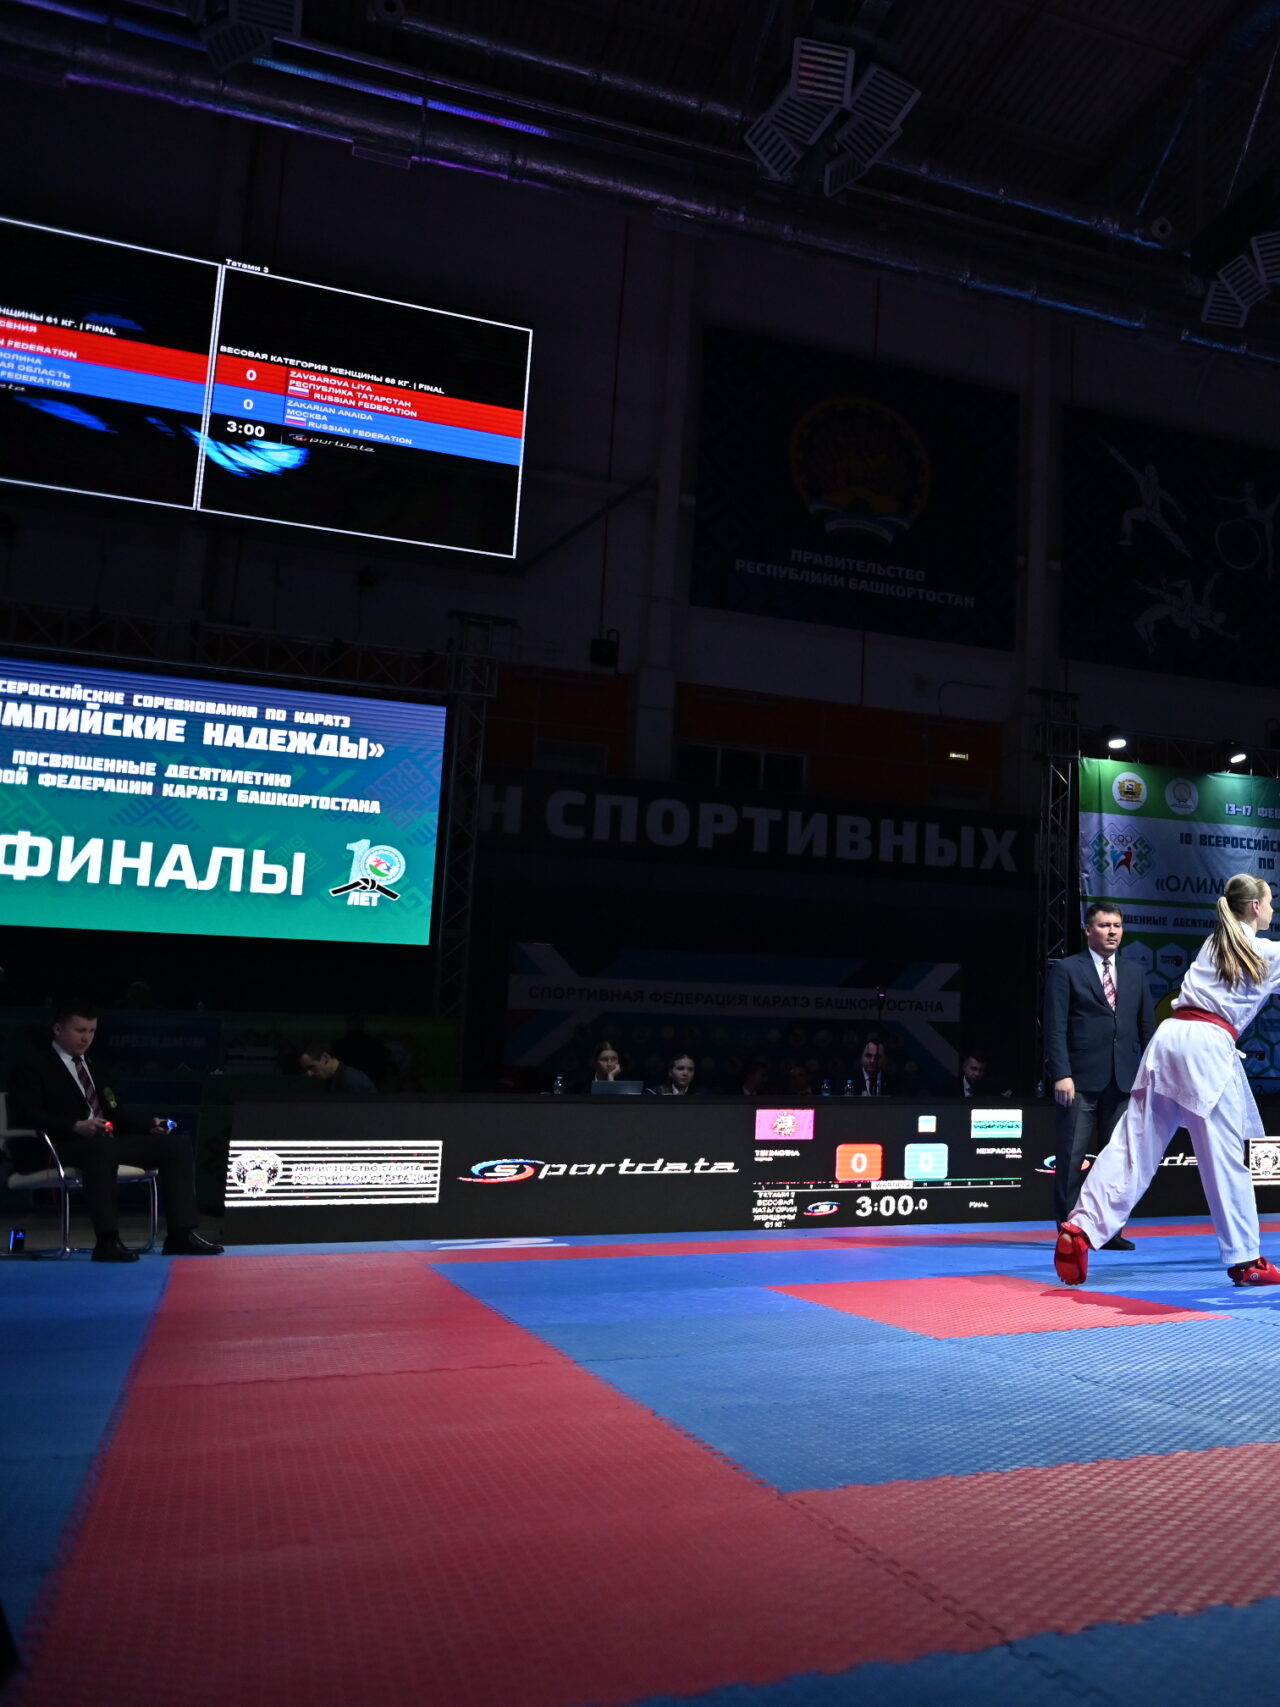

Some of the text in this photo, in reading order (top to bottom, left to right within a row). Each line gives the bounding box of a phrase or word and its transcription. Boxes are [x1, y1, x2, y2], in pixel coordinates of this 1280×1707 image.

[226, 258, 261, 272] Татами
[85, 323, 117, 336] FINAL
[7, 340, 78, 359] FEDERATION
[1, 370, 71, 389] FEDERATION
[17, 363, 71, 380] ОБЛАСТЬ
[220, 345, 268, 361] ВЕСОВАЯ
[270, 354, 328, 373] КАТЕГОРИЯ
[330, 365, 382, 383] ЖЕНЩИНЫ
[418, 382, 445, 395] FINAL
[246, 369, 257, 381] 0
[290, 370, 373, 392] ZAVGAROVA LIYA
[243, 399, 254, 410] 0
[289, 379, 412, 408] РЕСПУБЛИКА ТАТАРСТАН
[286, 399, 373, 421] ZAKARIAN ANAIDA
[286, 408, 328, 422] МОСКВА
[313, 392, 417, 418] RUSSIAN FEDERATION
[226, 421, 265, 437] 3:00
[308, 420, 412, 446] RUSSIAN FEDERATION
[790, 549, 927, 583] ПРАВИТЕЛЬСТВО
[735, 558, 977, 609] РЕСПУБЛИКИ БАШКОРТОСТАН
[132, 694, 258, 719] СОРЕВНОВАНИЯ
[265, 708, 286, 722] ПО
[294, 711, 351, 728] КАРАТЭ
[0, 701, 385, 760] МПИЙСКИЕ НАДЕЖДЫ»
[12, 750, 292, 788] ПОСВЯЩЕННЫЕ ДЕСЯТИЛЕТИЮ
[38, 773, 153, 796] ФЕДЕРАЦИИ
[162, 783, 228, 802] КАРАТЭ
[237, 789, 381, 814] БАШКОРТОСТАНА
[545, 789, 1019, 873] СПОРТИВНЫХ
[0, 830, 306, 896] ФИНАЛЫ
[1258, 857, 1275, 870] ПО
[346, 891, 381, 907] ЛЕТ
[528, 985, 645, 1003] СПОРТИВНАЯ
[649, 991, 749, 1008] ФЕДЕРАЦИЯ
[752, 995, 811, 1011] КАРАТЭ
[851, 1152, 935, 1174] 0 0
